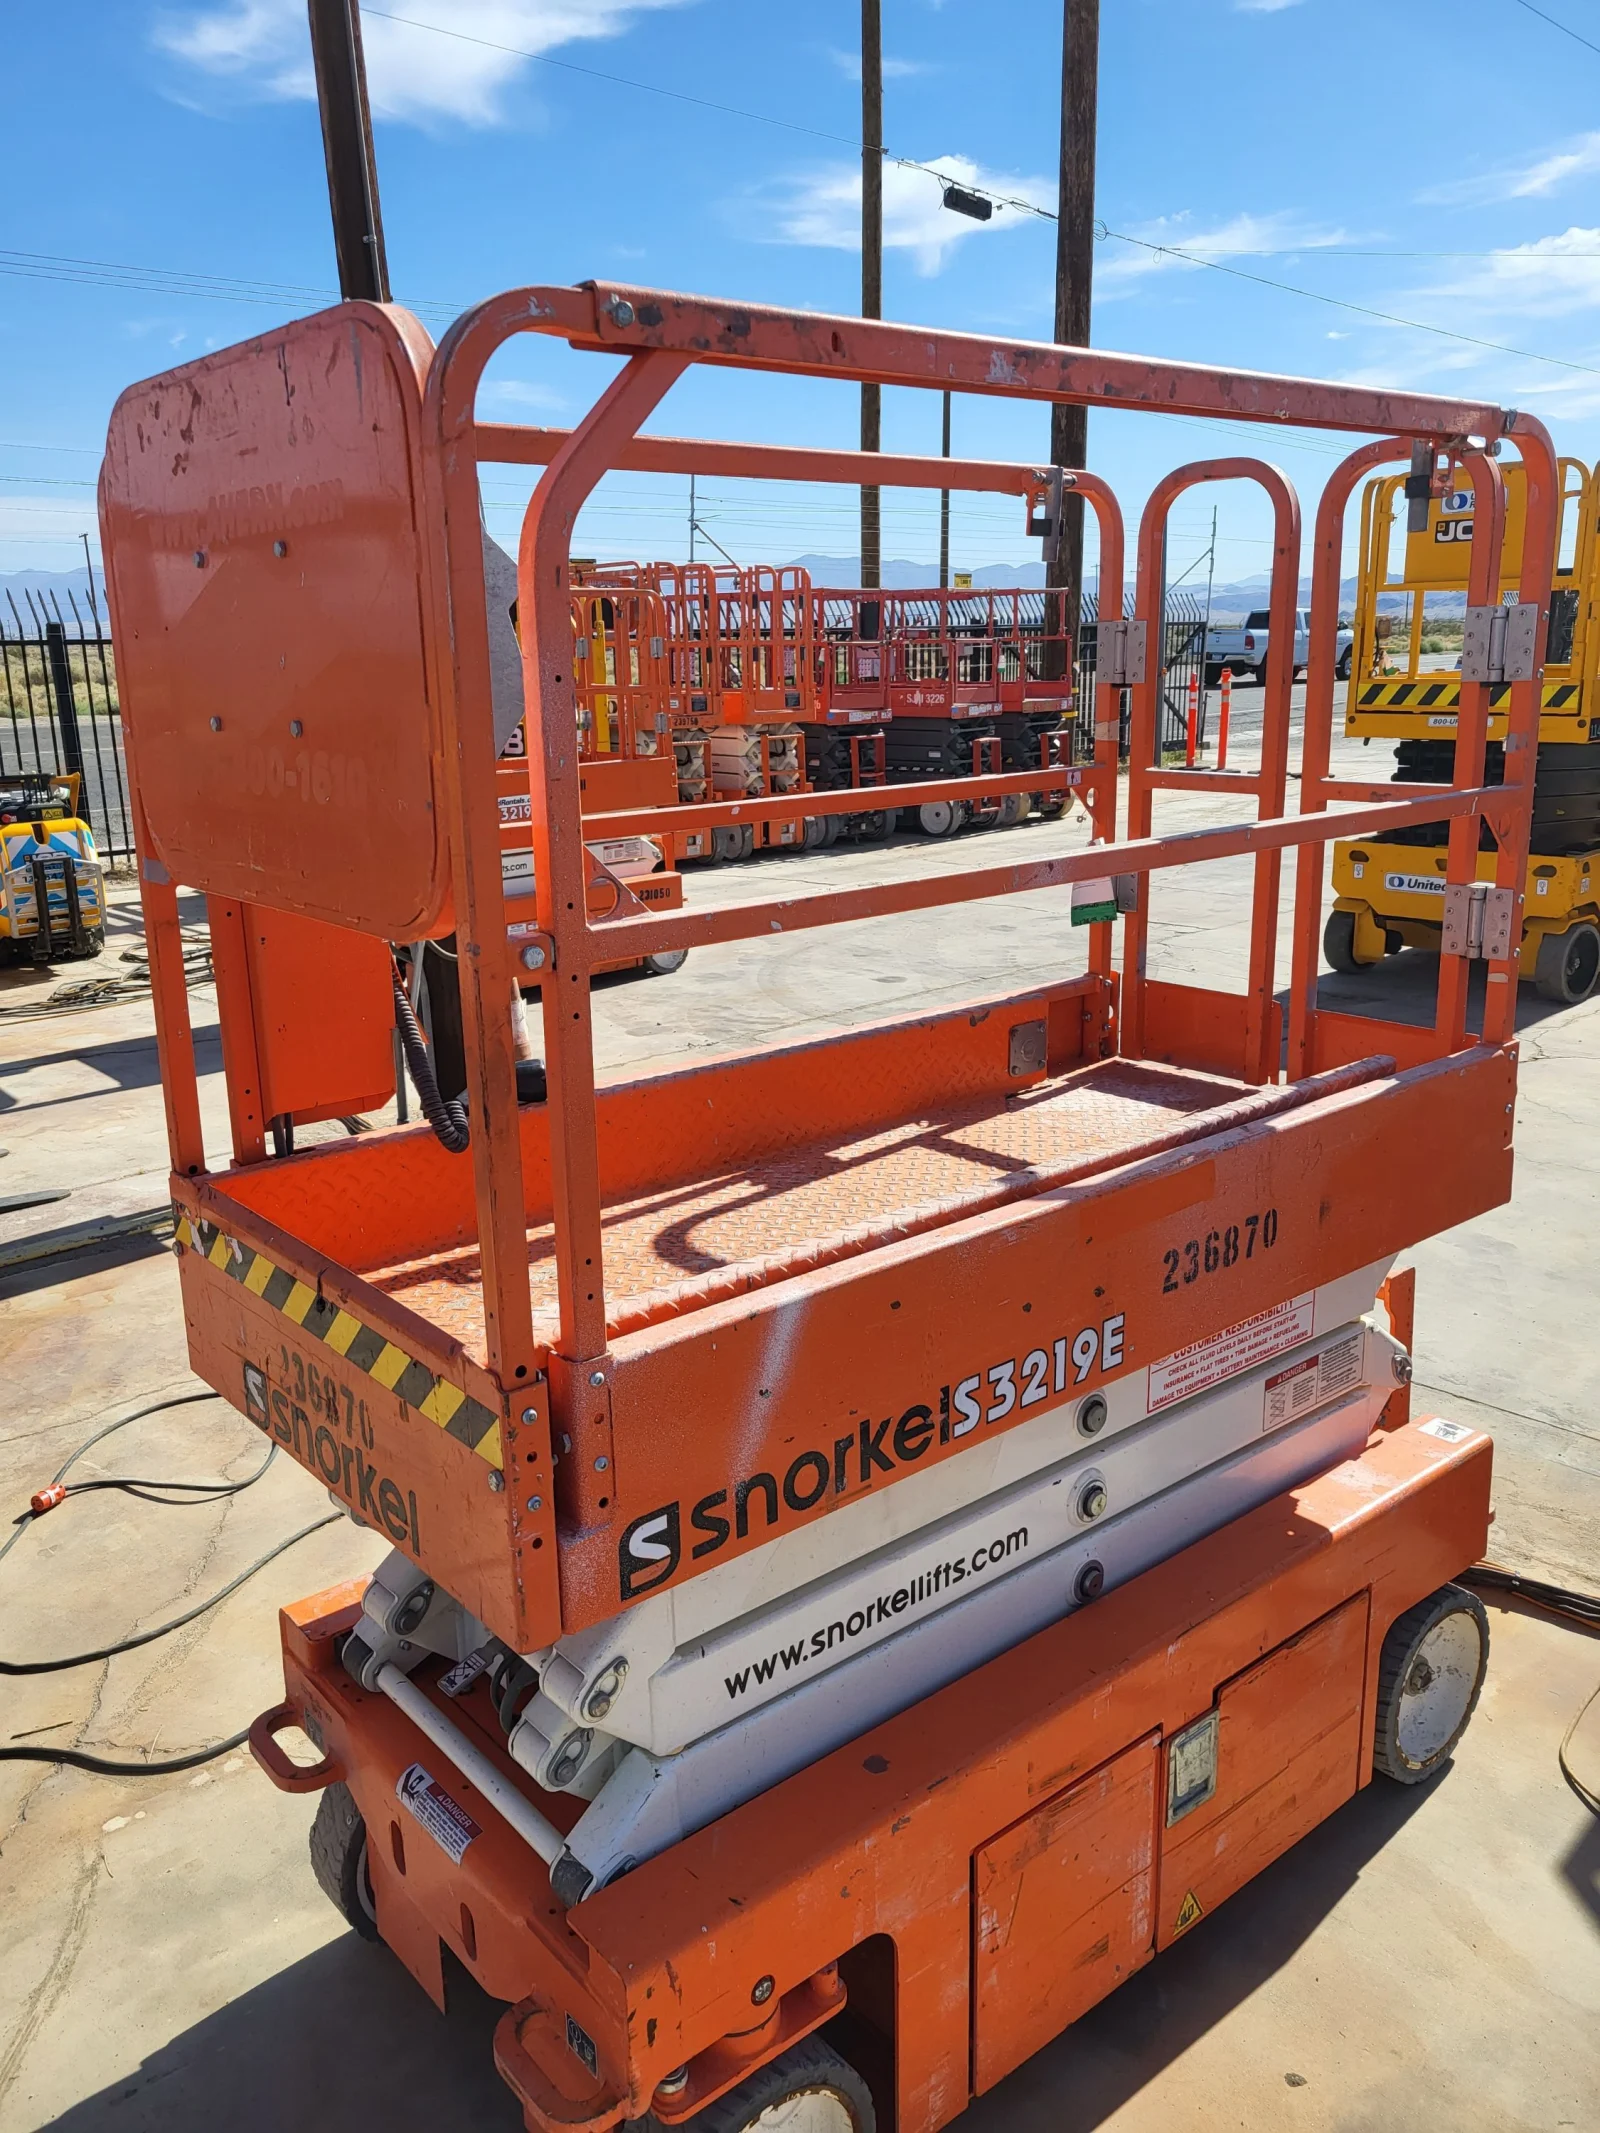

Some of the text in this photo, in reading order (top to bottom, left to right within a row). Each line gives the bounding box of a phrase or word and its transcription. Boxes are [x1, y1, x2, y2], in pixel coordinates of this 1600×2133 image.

[1437, 521, 1473, 542] JC
[925, 693, 945, 704] 3226
[1162, 1208, 1277, 1294] 236870
[953, 1312, 1126, 1439] S3219E
[1152, 1330, 1309, 1407] DAMAGE TO EQUIPMENT BATTERY MAINTENANCE CLEANING
[1163, 1323, 1300, 1390] INSURANCE FLAT TIRES TIRE DAMAGE REFUELING
[1168, 1364, 1188, 1377] CHECK
[1200, 1350, 1216, 1363] FLUID
[1216, 1340, 1236, 1354] LEVELS
[1237, 1334, 1252, 1346] DAILY
[1252, 1326, 1273, 1338] BEFORE
[1273, 1313, 1297, 1329] START-UP
[1282, 1362, 1307, 1381] DANGER
[271, 1388, 421, 1558] snorkel
[690, 1386, 950, 1561] snorkel
[724, 1526, 1029, 1699] www.snorkellifts.com
[441, 1799, 472, 1829] DANGER
